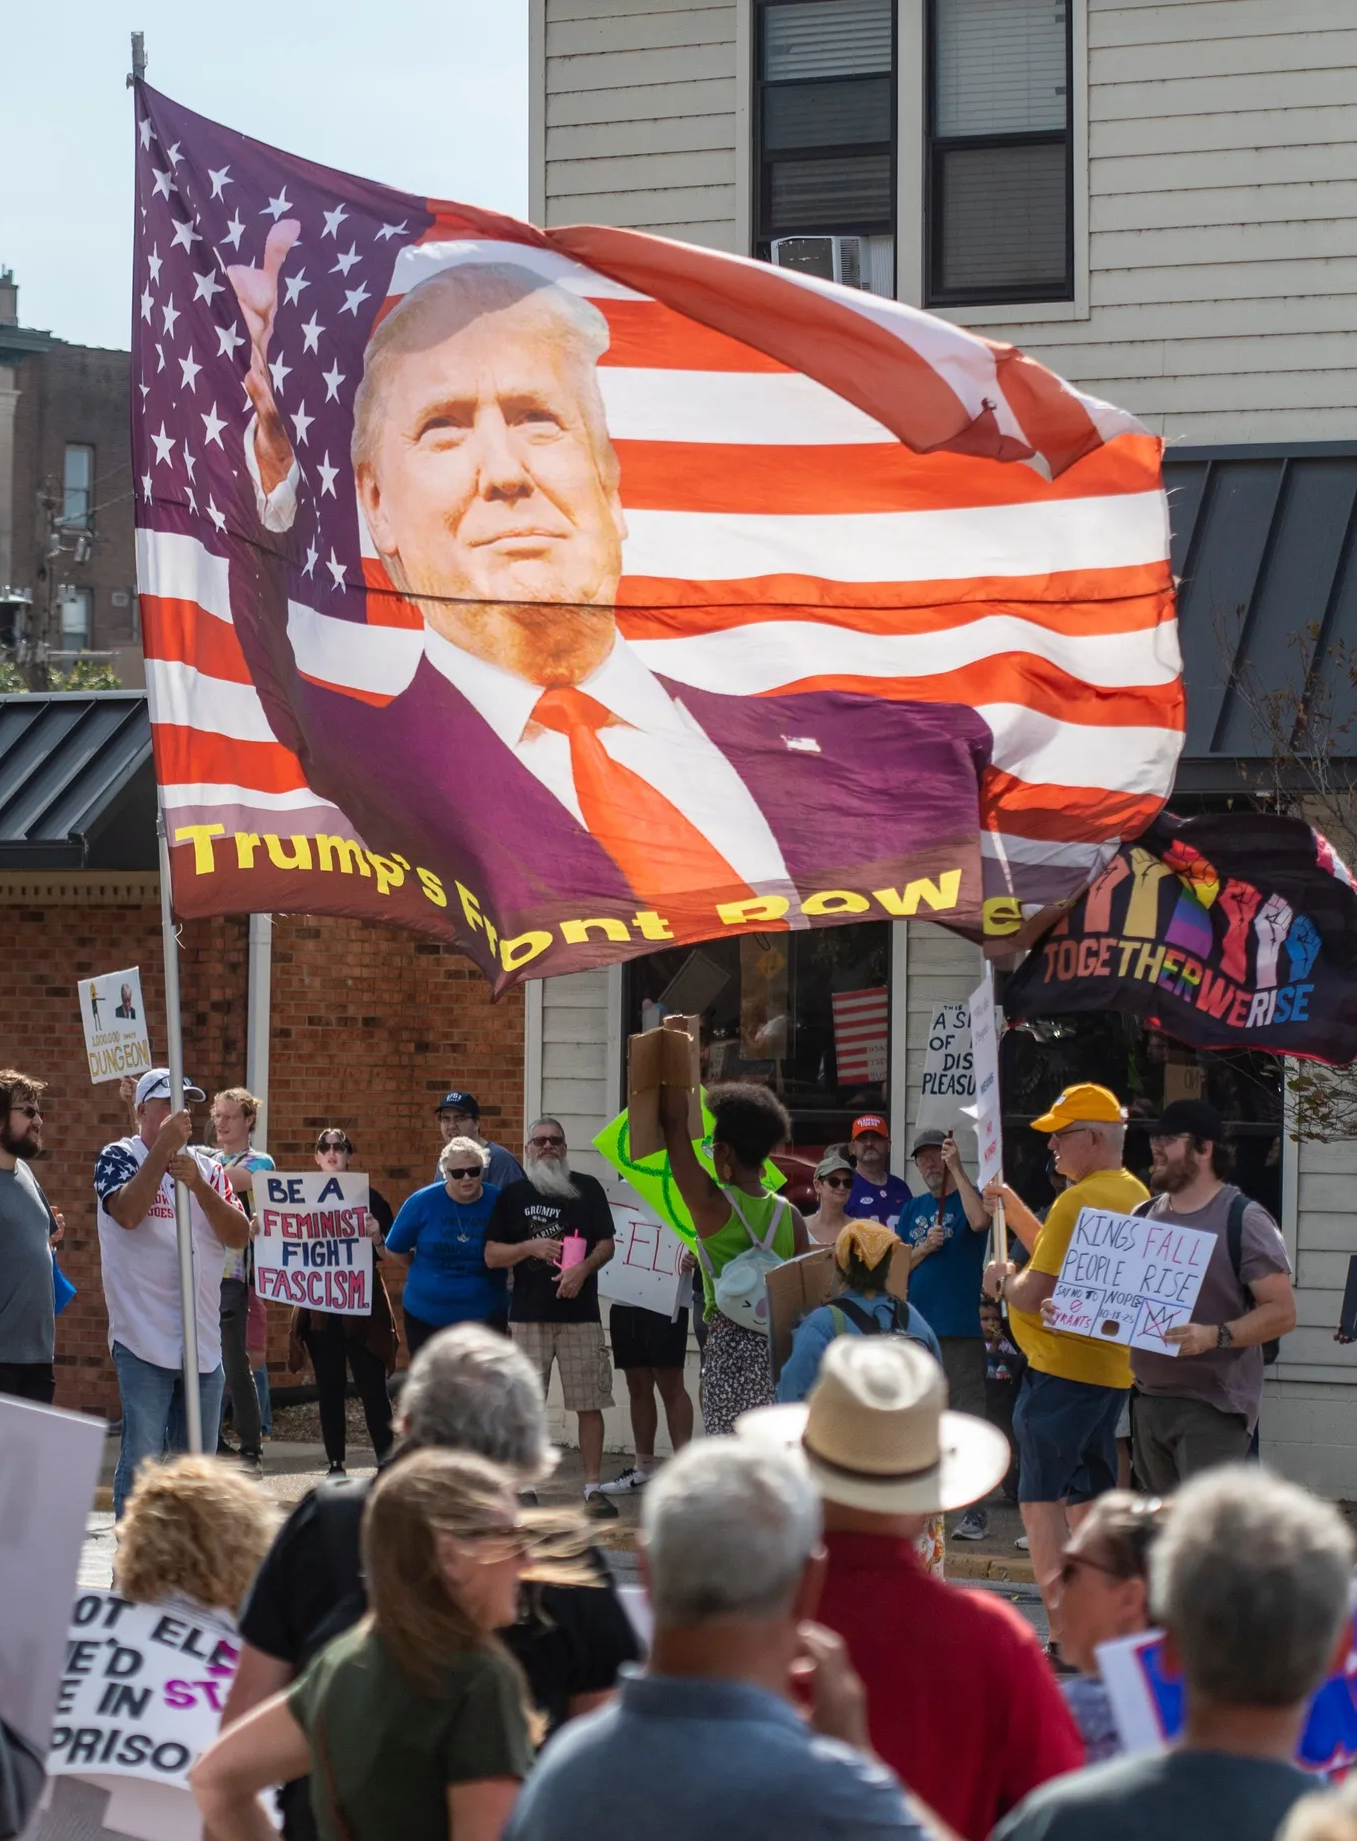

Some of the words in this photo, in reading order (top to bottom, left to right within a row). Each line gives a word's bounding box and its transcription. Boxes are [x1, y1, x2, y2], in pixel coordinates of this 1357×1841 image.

[175, 823, 447, 895] Trump's
[454, 879, 675, 972] Front
[1043, 938, 1201, 1003] TOGETHER
[1195, 970, 1253, 1028] WE
[1245, 983, 1314, 1028] RISE
[933, 1012, 946, 1030] A
[953, 1011, 971, 1029] SI
[929, 1034, 955, 1051] OF
[942, 1053, 974, 1072] DIS
[921, 1073, 976, 1096] PLEASU
[267, 1178, 306, 1204] BE
[317, 1177, 345, 1203] A
[147, 1207, 174, 1219] JOES
[263, 1206, 369, 1239] FEMINIST
[524, 1204, 562, 1219] GRUMPY
[532, 1215, 548, 1223] OLD
[530, 1222, 562, 1241] ARINE
[1076, 1213, 1139, 1251] KINGS
[1142, 1227, 1201, 1266] FALL
[282, 1238, 360, 1267] FIGHT
[258, 1266, 371, 1310] FASCISM.
[1061, 1249, 1125, 1286] PEOPLE
[1139, 1264, 1198, 1302] RISE
[1056, 1285, 1068, 1299] SAY
[1070, 1288, 1083, 1299] NO
[1050, 1304, 1092, 1329] TYRANTS
[63, 1637, 145, 1679] E'D
[56, 1679, 83, 1715] E
[96, 1682, 154, 1719] IN
[163, 1679, 224, 1714] ST
[51, 1726, 192, 1775] PRISO
